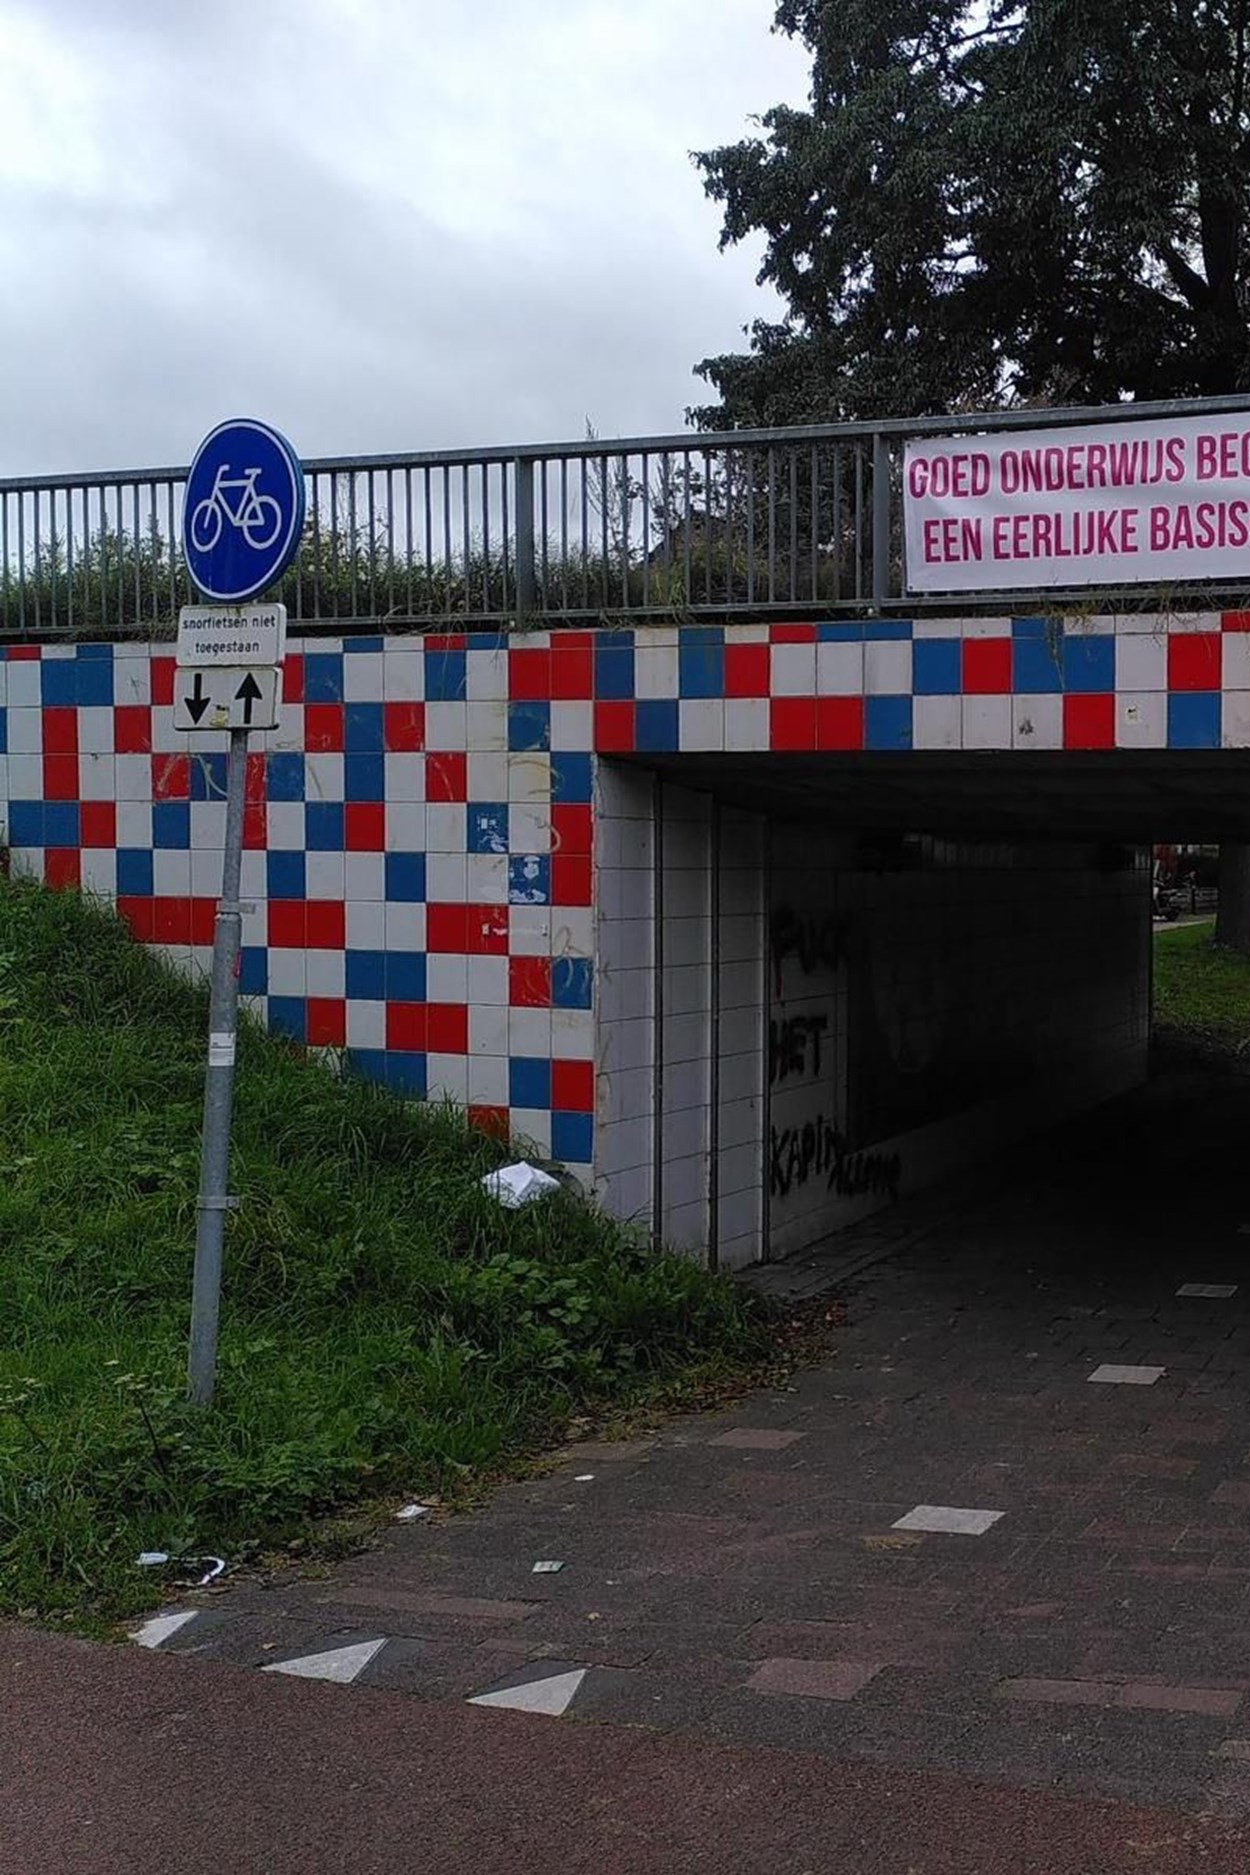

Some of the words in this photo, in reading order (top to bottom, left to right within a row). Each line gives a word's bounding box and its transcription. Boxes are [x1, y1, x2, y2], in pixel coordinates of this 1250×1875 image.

[909, 453, 990, 498] GOED
[1001, 437, 1185, 494] ONDERWIJS
[924, 518, 983, 562] EEN
[993, 508, 1138, 560] EERLIJKE
[183, 617, 248, 629] snorfietsen
[252, 615, 276, 627] niet
[195, 641, 260, 656] toegestaan
